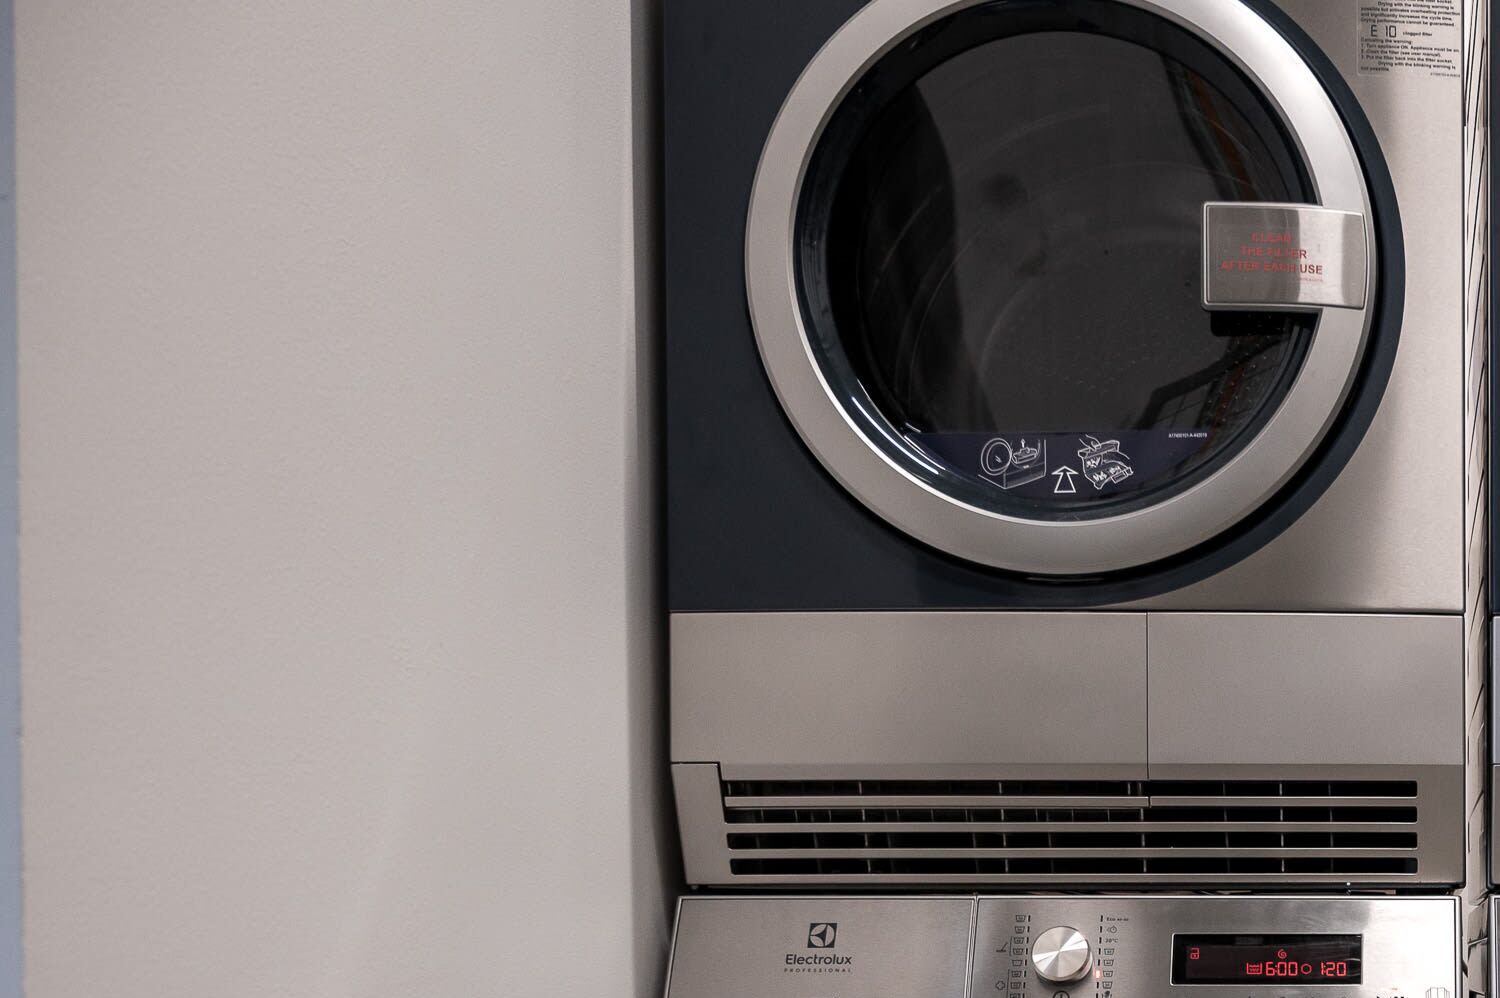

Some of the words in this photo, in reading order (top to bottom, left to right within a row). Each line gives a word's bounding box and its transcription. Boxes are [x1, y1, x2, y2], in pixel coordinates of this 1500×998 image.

[1371, 25, 1378, 37] E
[1300, 264, 1323, 275] USE
[785, 954, 852, 965] Electrolux
